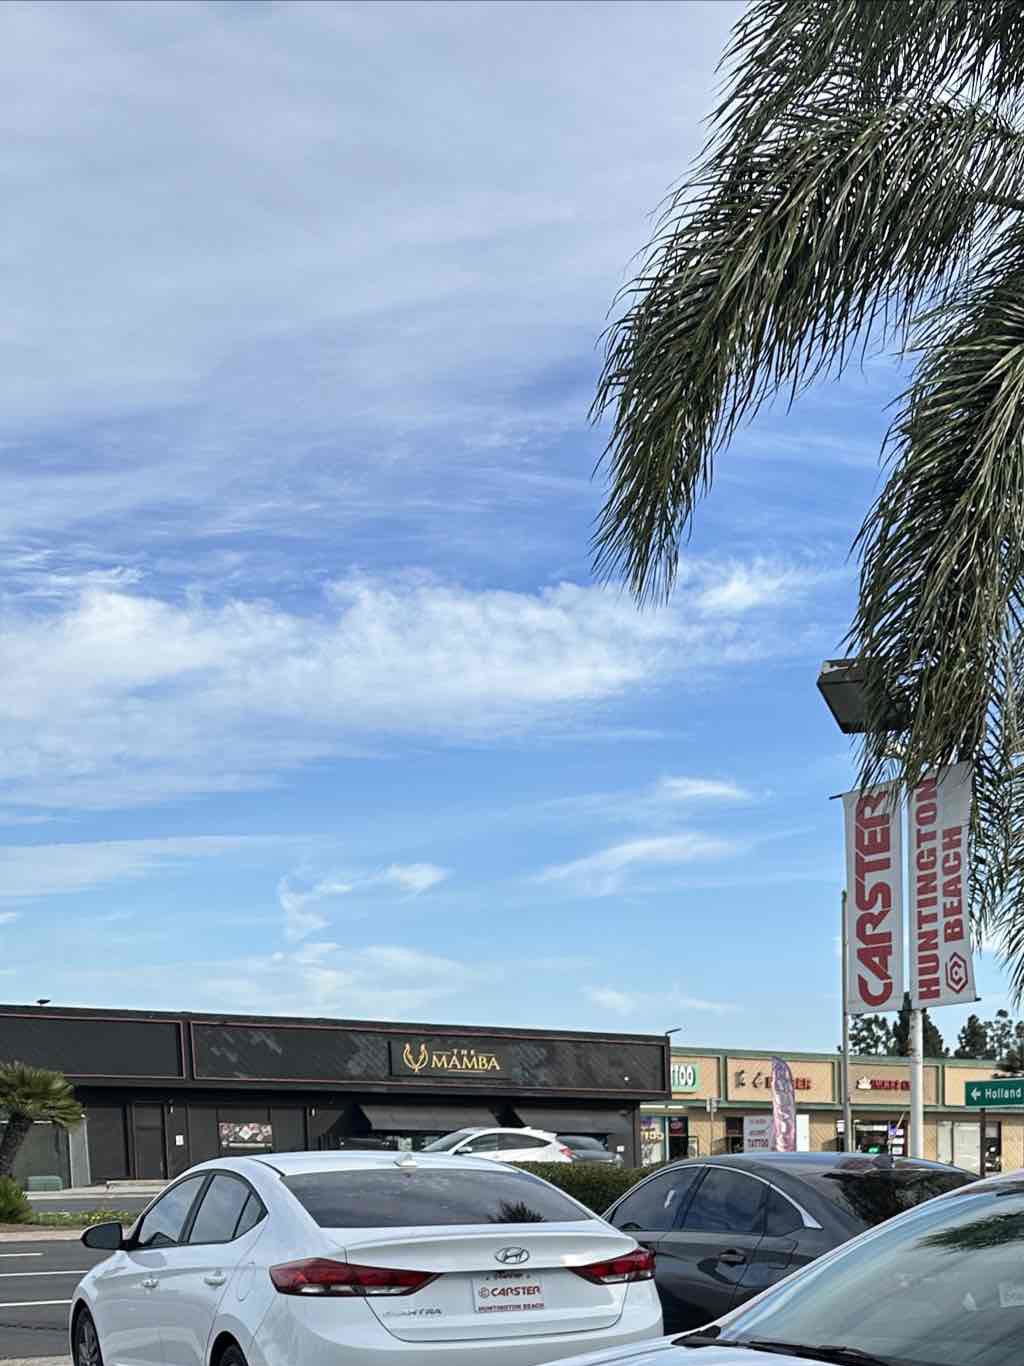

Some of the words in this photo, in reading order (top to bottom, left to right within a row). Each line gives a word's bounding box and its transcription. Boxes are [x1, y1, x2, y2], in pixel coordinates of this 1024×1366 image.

[855, 789, 892, 1007] CARSTER
[915, 777, 941, 1001] HUNTINGTON
[942, 825, 964, 943] BEACH
[431, 1055, 501, 1070] MAMBA
[984, 1087, 1022, 1100] Holland
[490, 1285, 541, 1297] CARSTER
